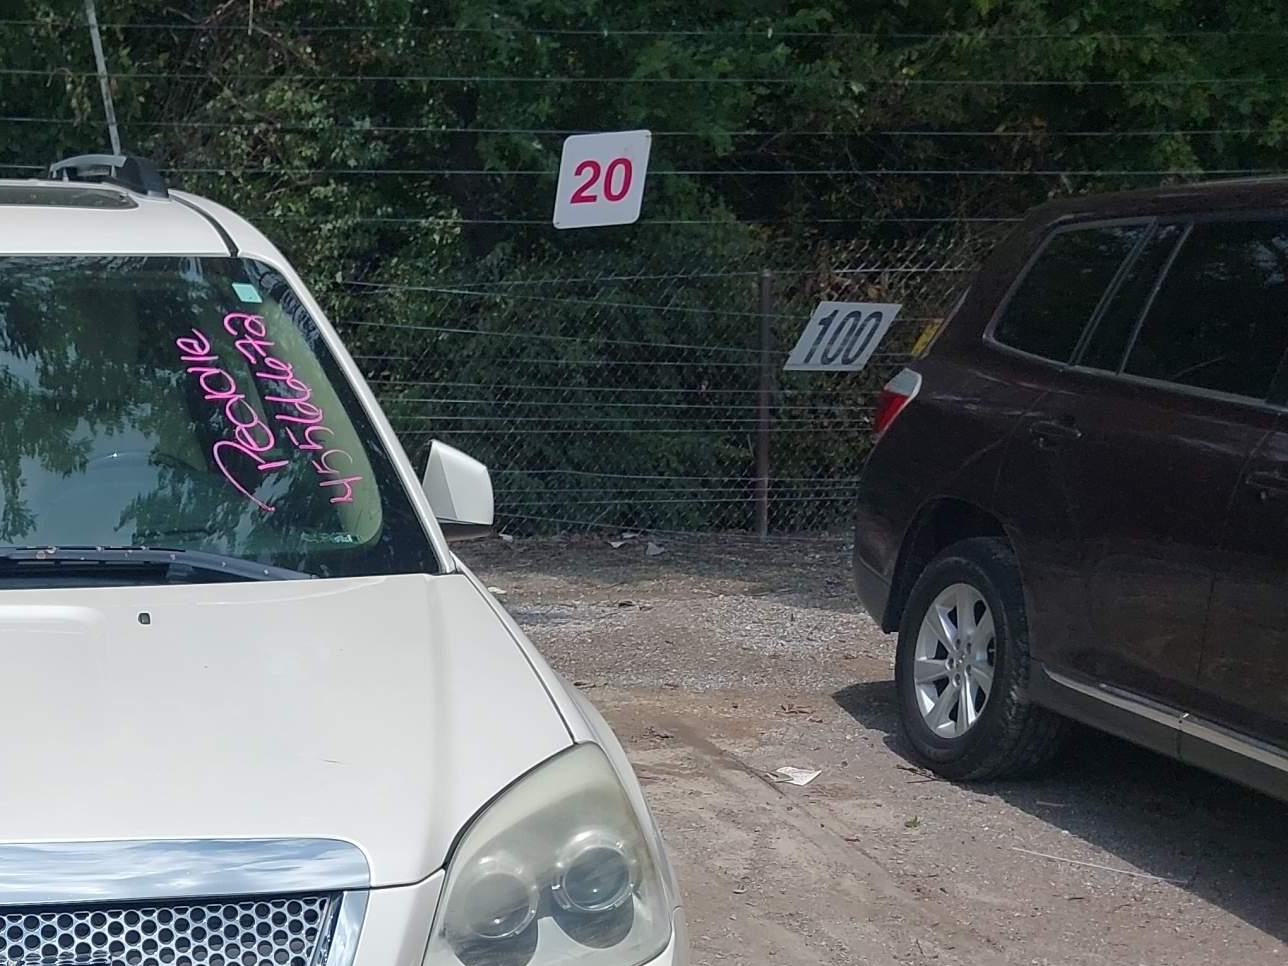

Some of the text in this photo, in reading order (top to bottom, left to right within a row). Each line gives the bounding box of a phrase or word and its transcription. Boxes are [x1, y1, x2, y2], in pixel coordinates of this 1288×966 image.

[569, 156, 634, 205] 20
[801, 308, 884, 366] 100
[223, 312, 363, 504] 45566672
